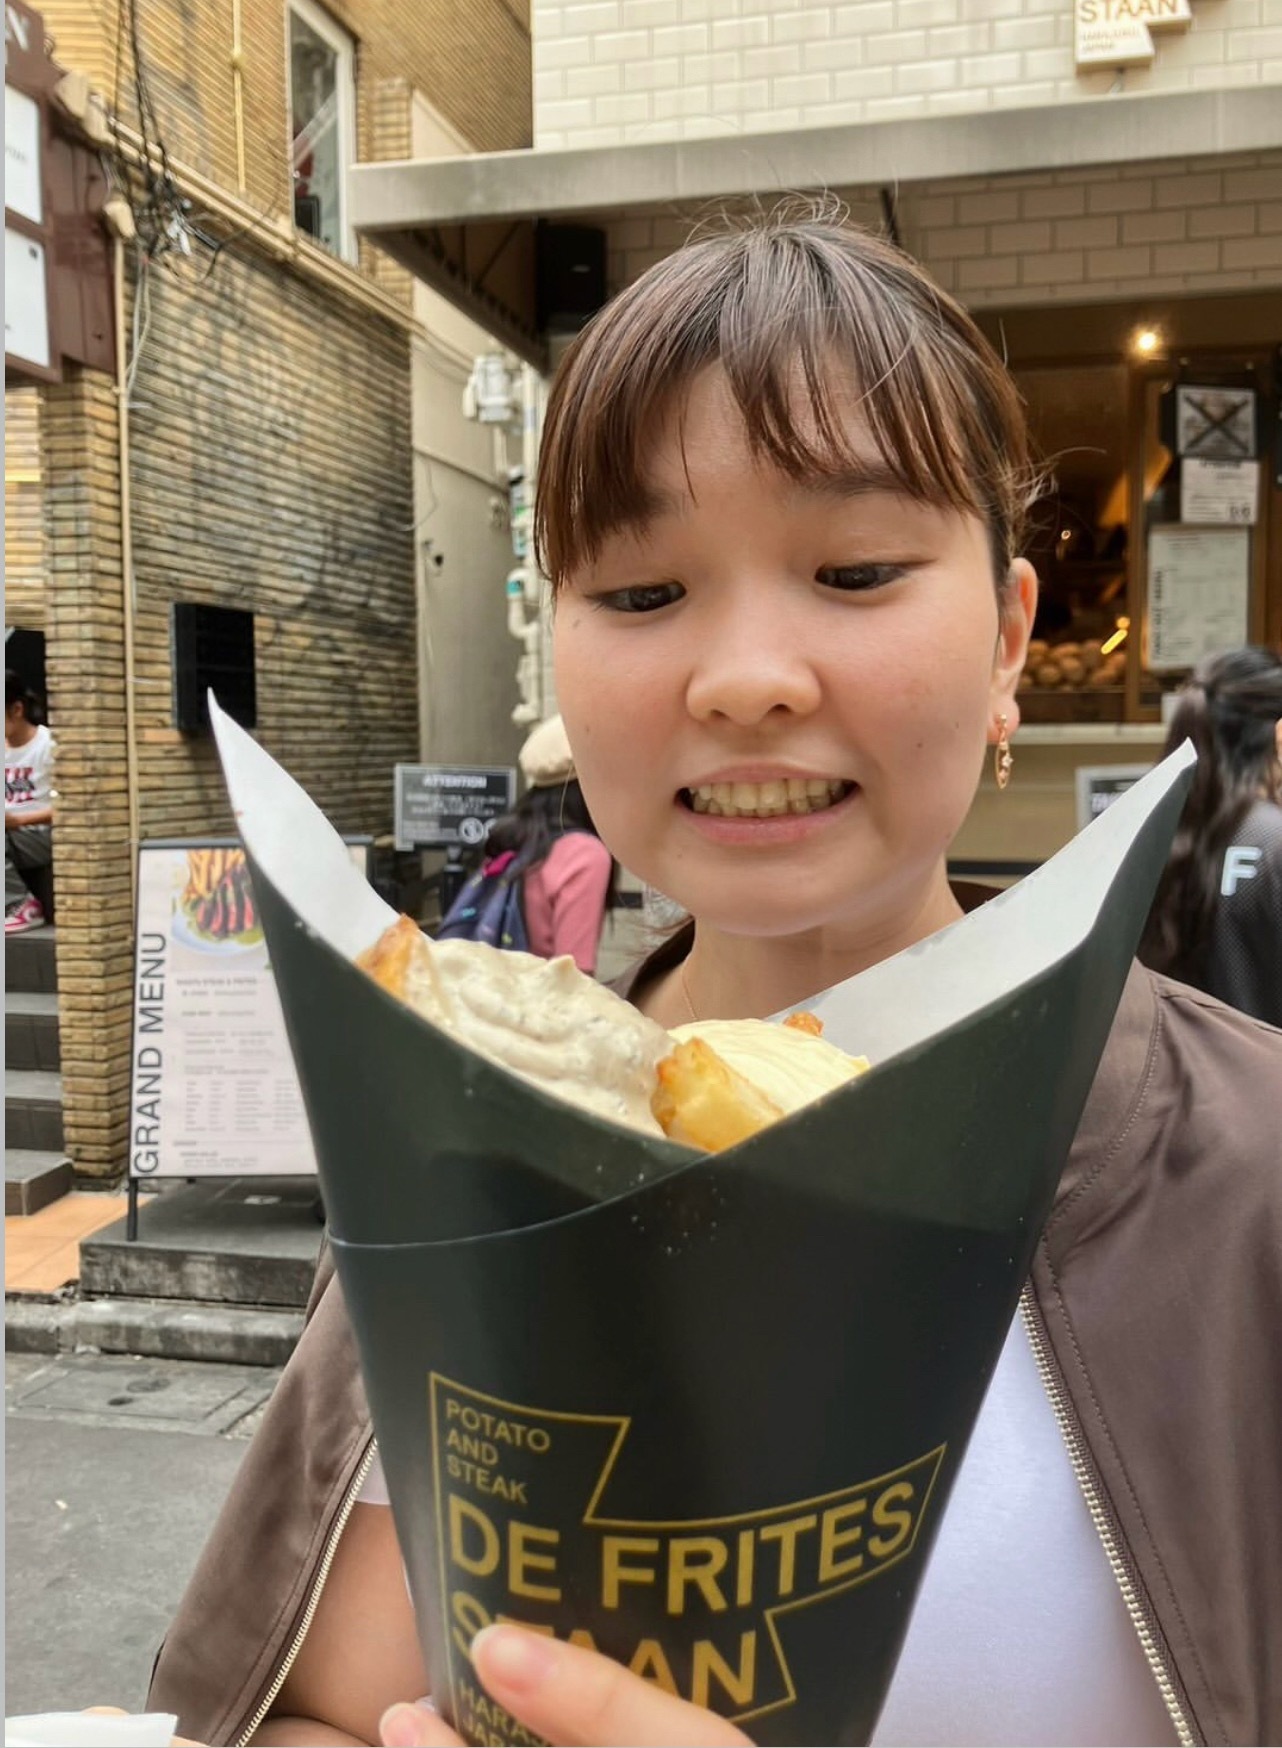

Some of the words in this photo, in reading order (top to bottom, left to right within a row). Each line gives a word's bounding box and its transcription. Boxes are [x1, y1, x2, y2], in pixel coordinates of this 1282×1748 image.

[1080, 0, 1177, 23] STAAN
[1221, 846, 1262, 897] F
[138, 932, 167, 1033] MENU
[133, 1047, 163, 1175] GRAND
[446, 1398, 551, 1452] POTATO
[446, 1427, 499, 1467] AND
[446, 1454, 528, 1505] STEAK
[449, 1492, 561, 1602] DE
[602, 1481, 914, 1615] FRITES
[452, 1590, 757, 1710] SAN
